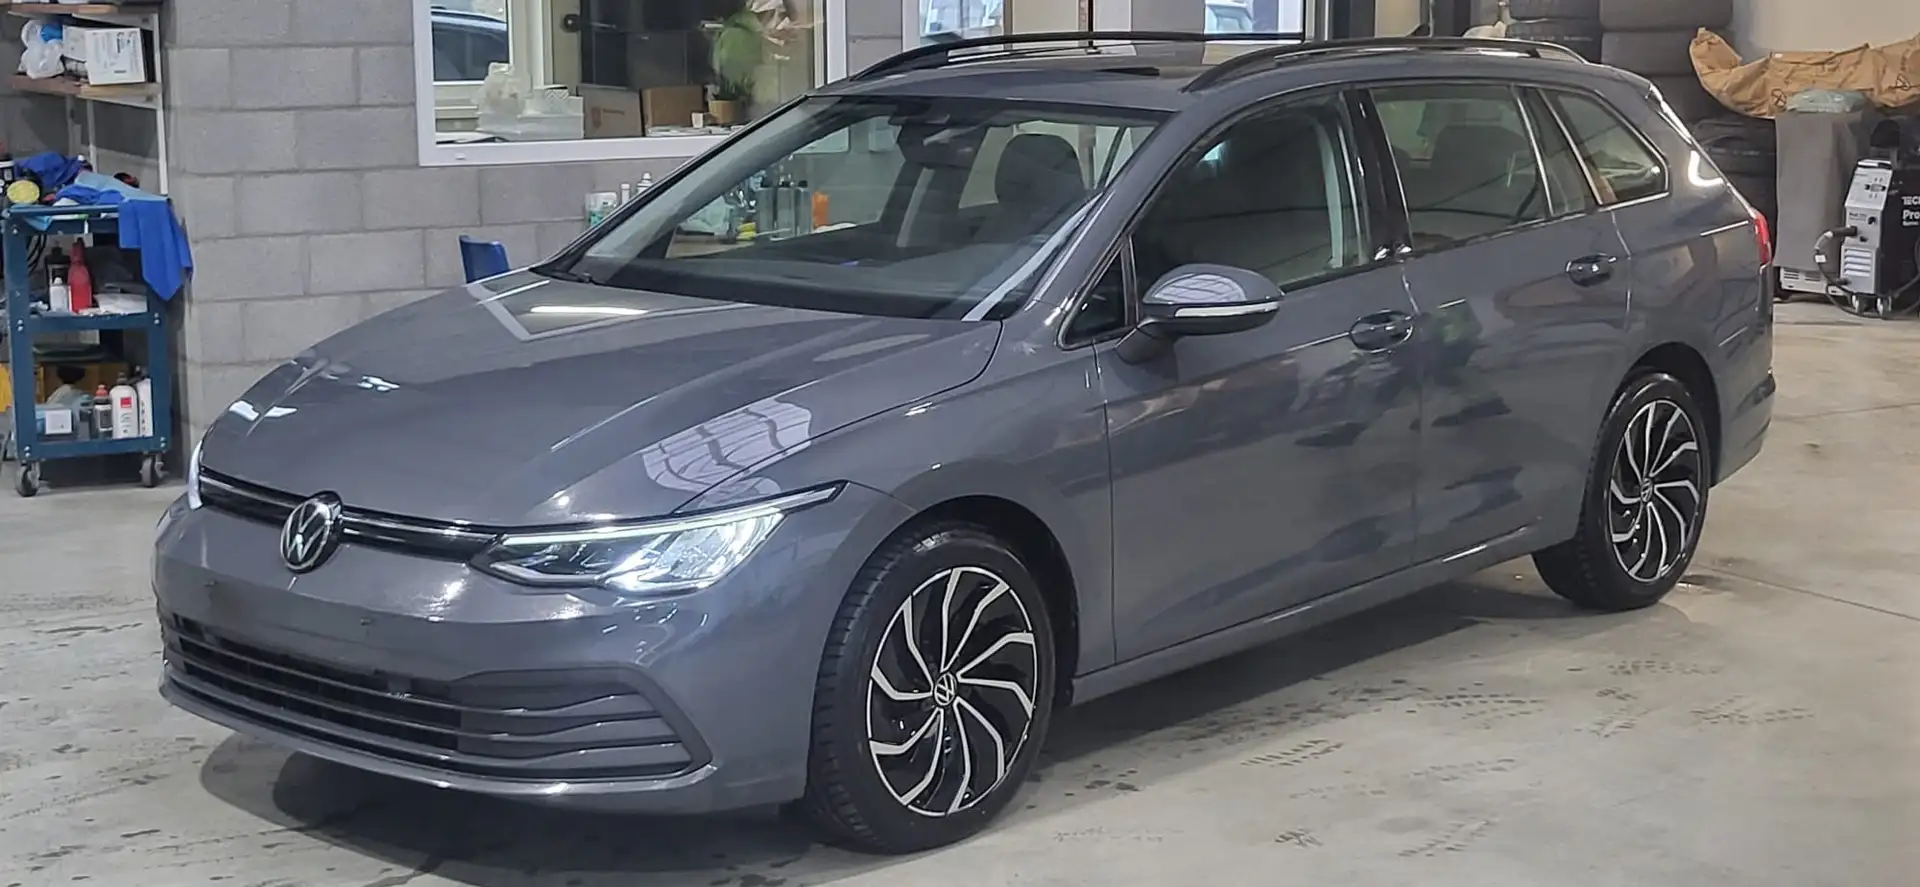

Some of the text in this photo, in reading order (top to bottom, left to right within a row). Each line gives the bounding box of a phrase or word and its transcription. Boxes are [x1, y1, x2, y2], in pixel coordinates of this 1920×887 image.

[1901, 196, 1920, 206] TEC
[281, 499, 331, 569] VW
[934, 672, 957, 706] VW
